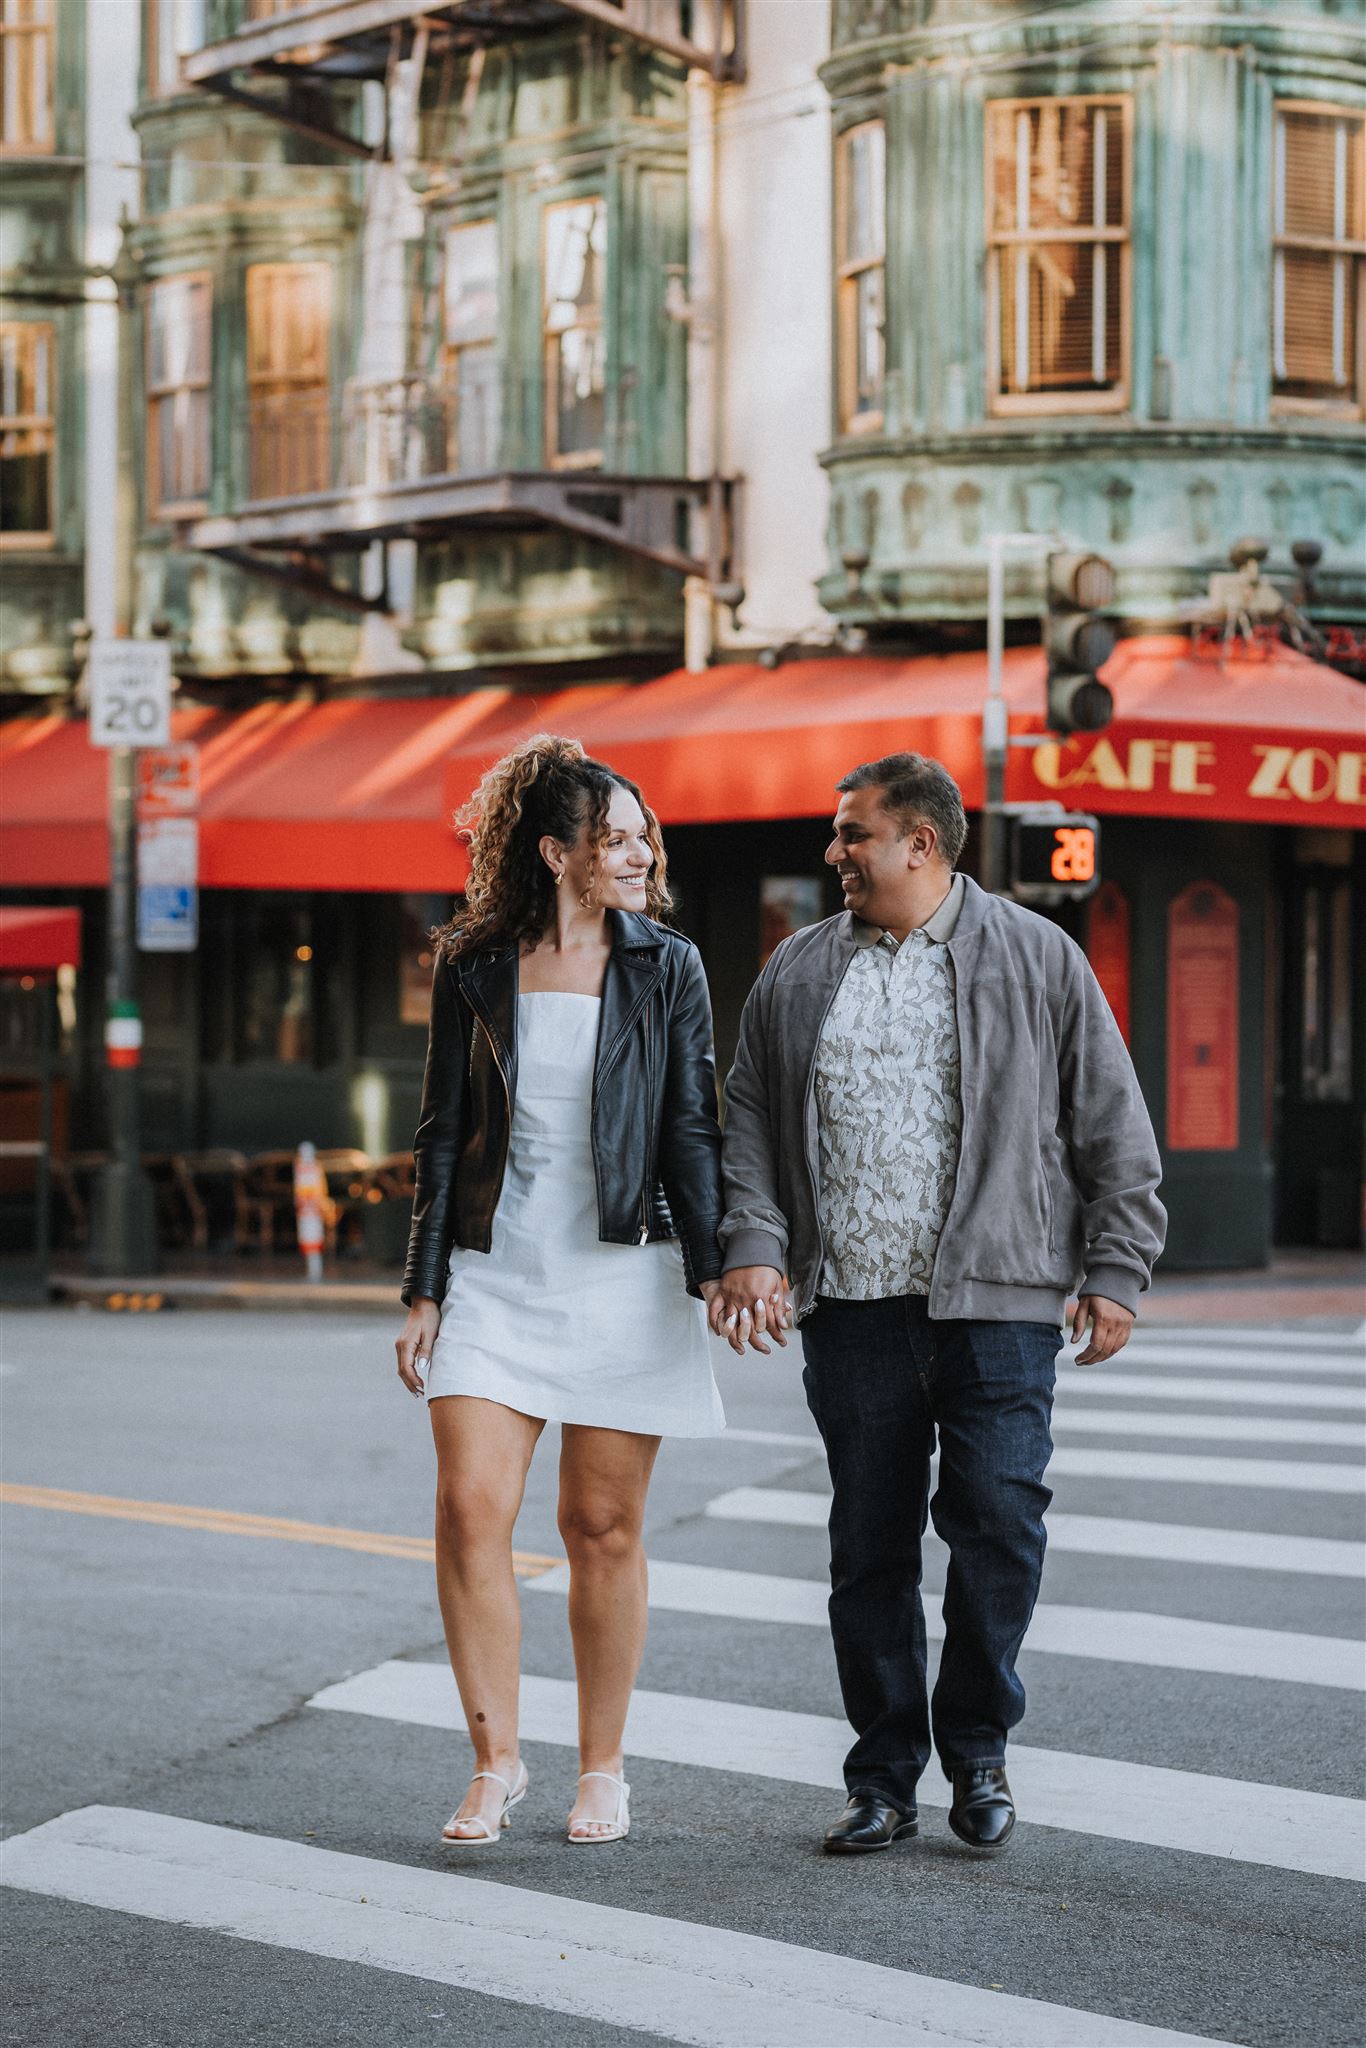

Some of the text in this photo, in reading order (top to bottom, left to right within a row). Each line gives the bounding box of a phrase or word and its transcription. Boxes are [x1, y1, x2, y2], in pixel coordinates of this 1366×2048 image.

[104, 695, 159, 731] 20
[1033, 738, 1217, 796] CAFE
[1051, 827, 1096, 881] 28
